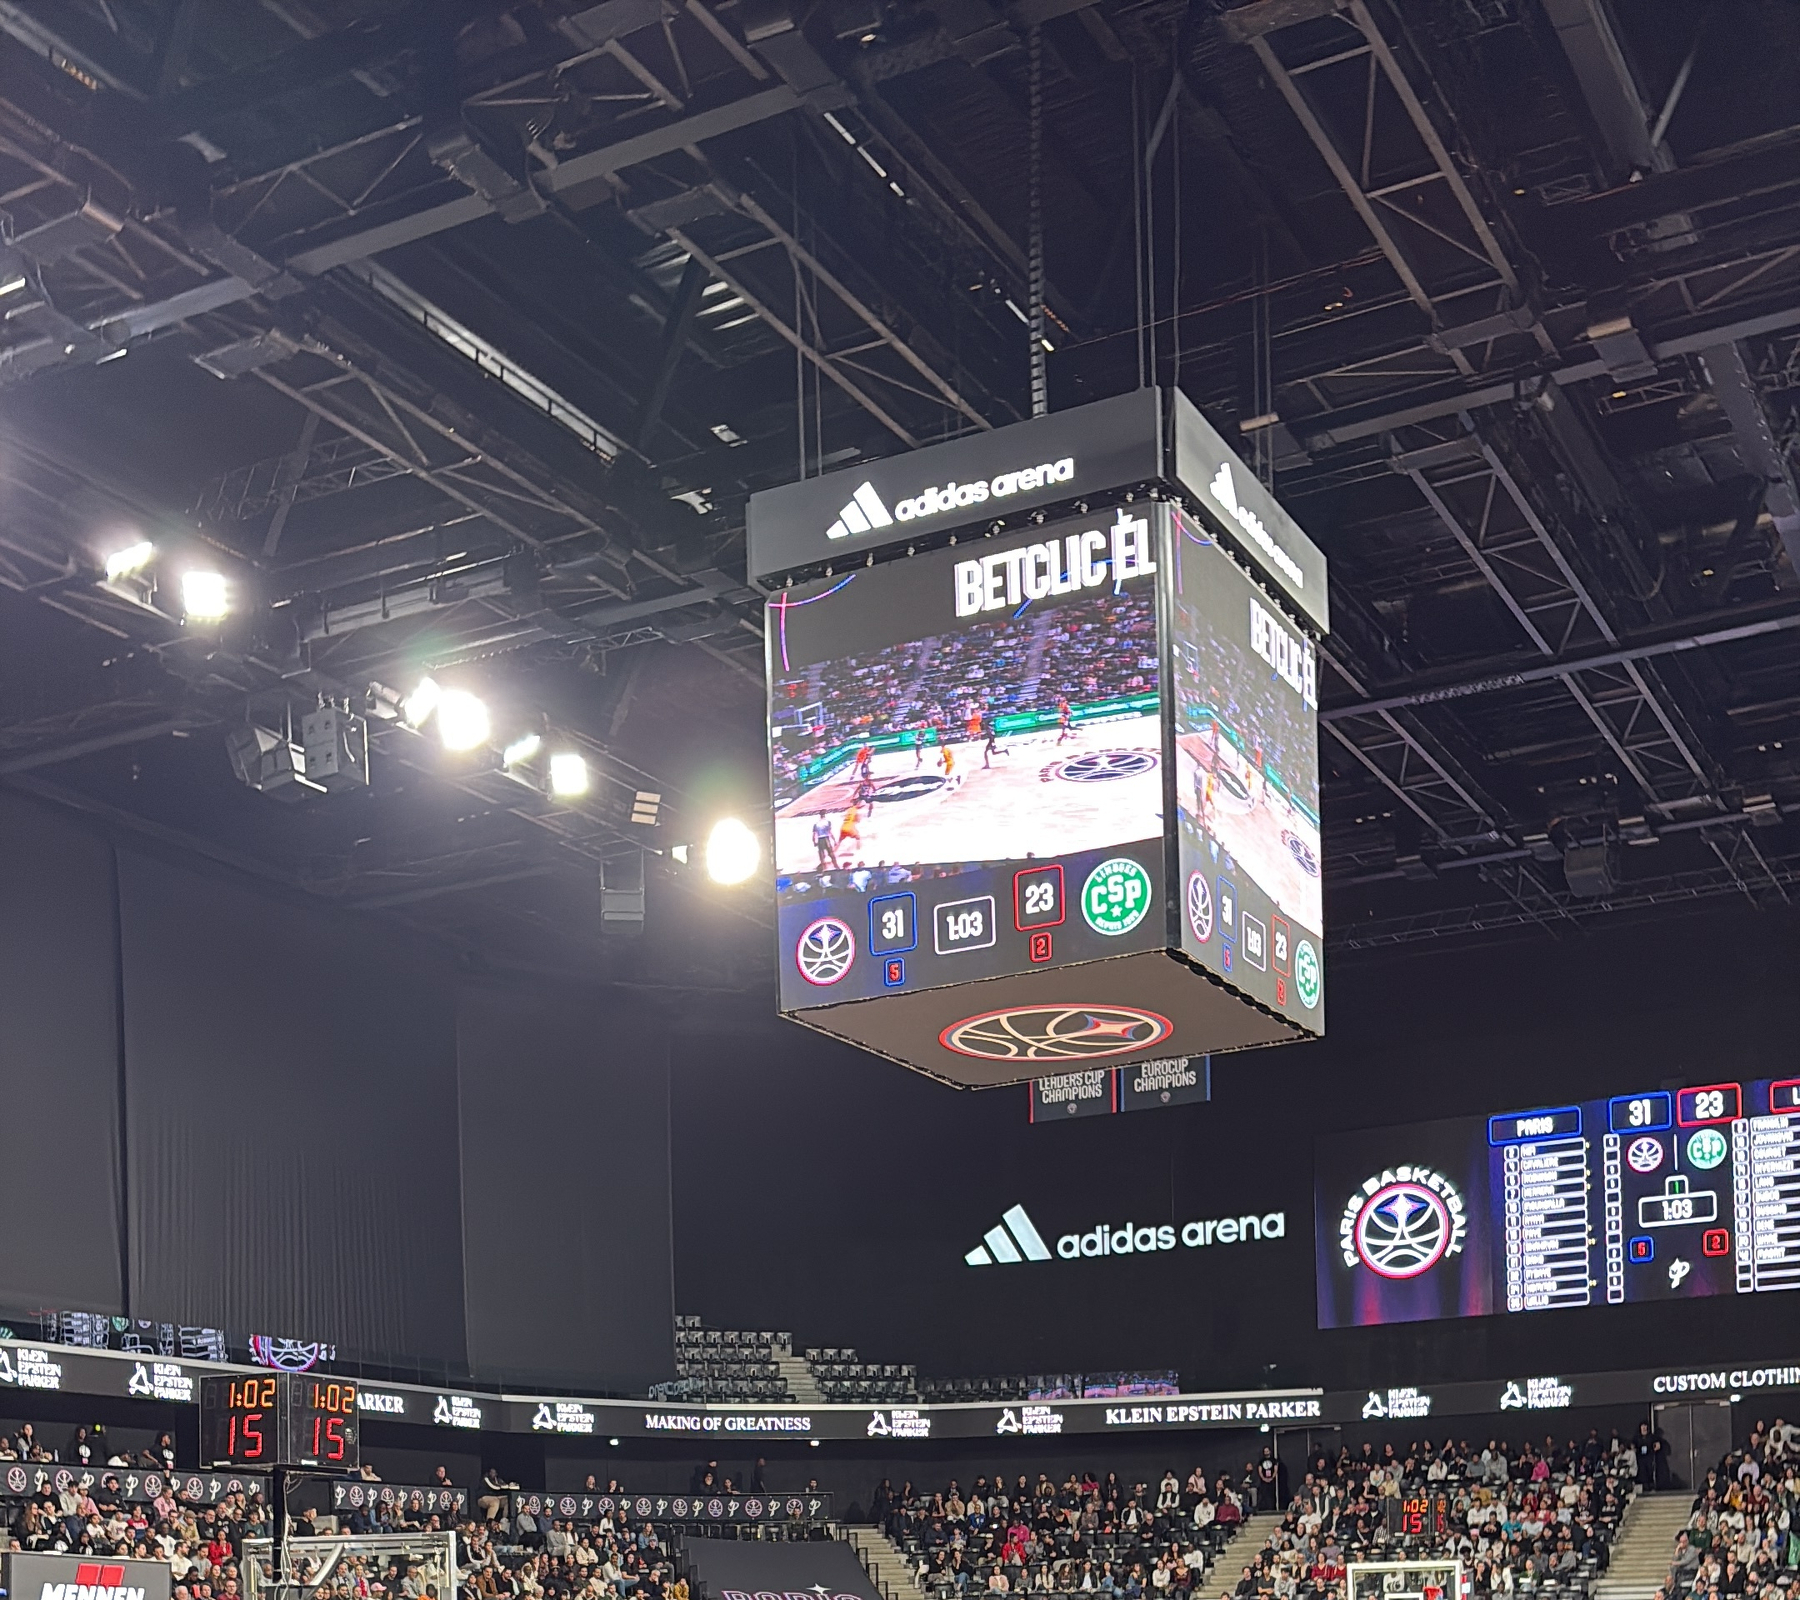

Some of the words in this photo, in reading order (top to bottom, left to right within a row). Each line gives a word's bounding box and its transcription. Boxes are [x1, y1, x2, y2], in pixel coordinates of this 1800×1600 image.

[894, 480, 989, 522] adidas
[990, 457, 1074, 497] arena
[954, 530, 1106, 617] BETCLIC
[1025, 883, 1054, 914] 23
[1091, 874, 1142, 915] CSP
[881, 909, 904, 939] 31
[946, 910, 983, 941] 1:03
[1036, 939, 1046, 955] 2
[889, 965, 900, 981] 5
[1141, 1058, 1189, 1078] EUROCUP
[1038, 1072, 1084, 1091] LEADERS
[1084, 1070, 1106, 1085] CUP
[1134, 1070, 1197, 1092] CHAMPIONS
[1042, 1084, 1103, 1104] CHAMPIONS
[1695, 1090, 1724, 1118] 23
[1628, 1099, 1651, 1126] 31
[1516, 1117, 1553, 1137] PARIS
[1340, 1194, 1364, 1267] PARIS
[1362, 1166, 1466, 1258] BASKETBALL
[1662, 1198, 1693, 1220] 1:03
[1056, 1222, 1176, 1259] adidas
[1182, 1212, 1285, 1247] arena
[229, 1378, 276, 1409] 1:02
[1653, 1372, 1726, 1393] CUSTOM
[314, 1383, 356, 1414] 1:02
[357, 1393, 404, 1413] ARKER
[646, 1414, 700, 1430] MAKING
[703, 1416, 721, 1430] OF
[724, 1416, 811, 1431] GREATNESS
[1105, 1406, 1163, 1424] KLEIN
[1166, 1404, 1244, 1422] EPSTEIN
[1246, 1400, 1321, 1420] PARKER
[228, 1413, 263, 1458] 15
[312, 1417, 345, 1461] 15
[1402, 1499, 1429, 1513] 1:02
[1402, 1513, 1422, 1534] 15
